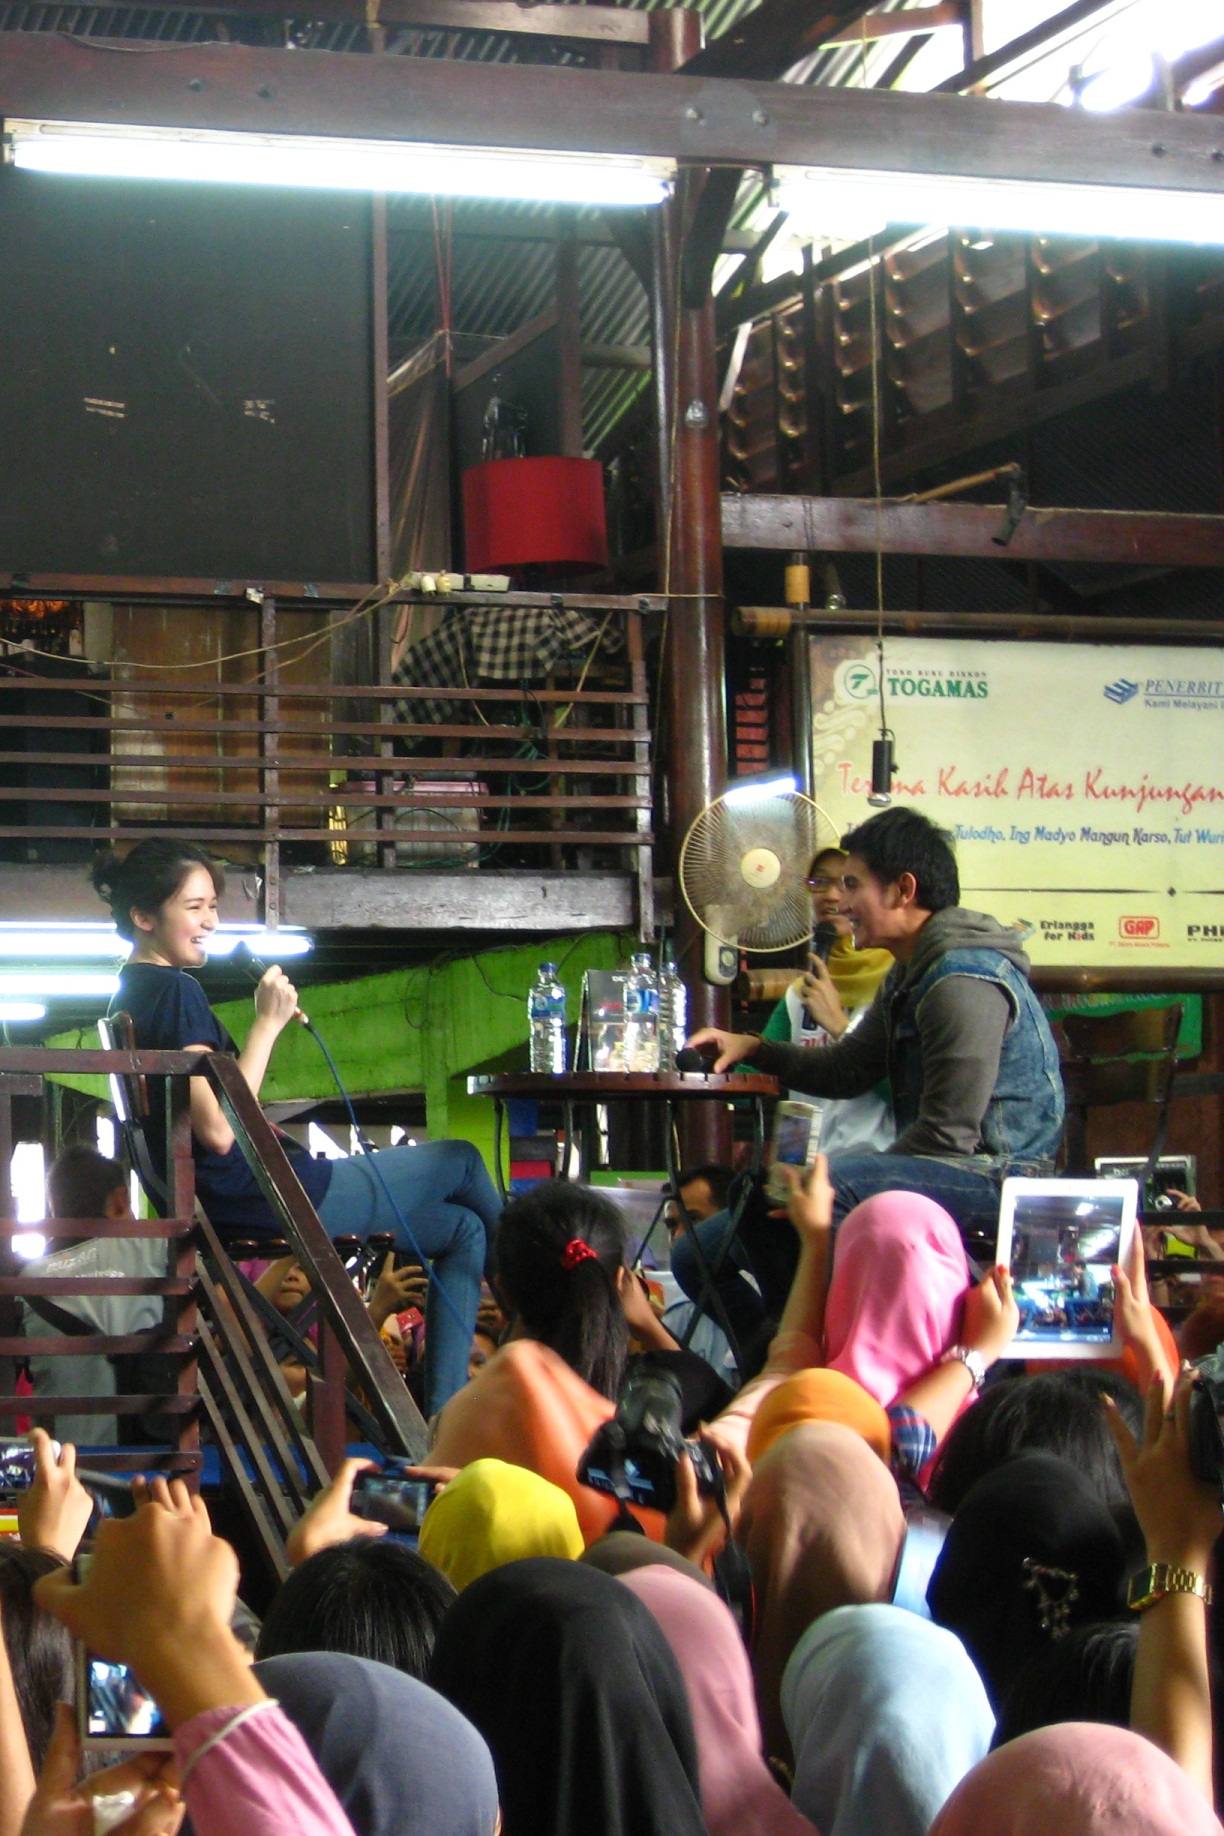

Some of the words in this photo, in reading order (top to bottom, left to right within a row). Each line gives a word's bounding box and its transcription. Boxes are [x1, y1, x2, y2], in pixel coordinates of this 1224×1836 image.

[887, 678, 988, 698] TOGAMAS
[838, 763, 927, 796] Terma
[938, 765, 1009, 798] Kasih
[1016, 767, 1074, 801] Atas
[1084, 768, 1224, 815] Kunjungan
[1034, 826, 1076, 845] Madyo
